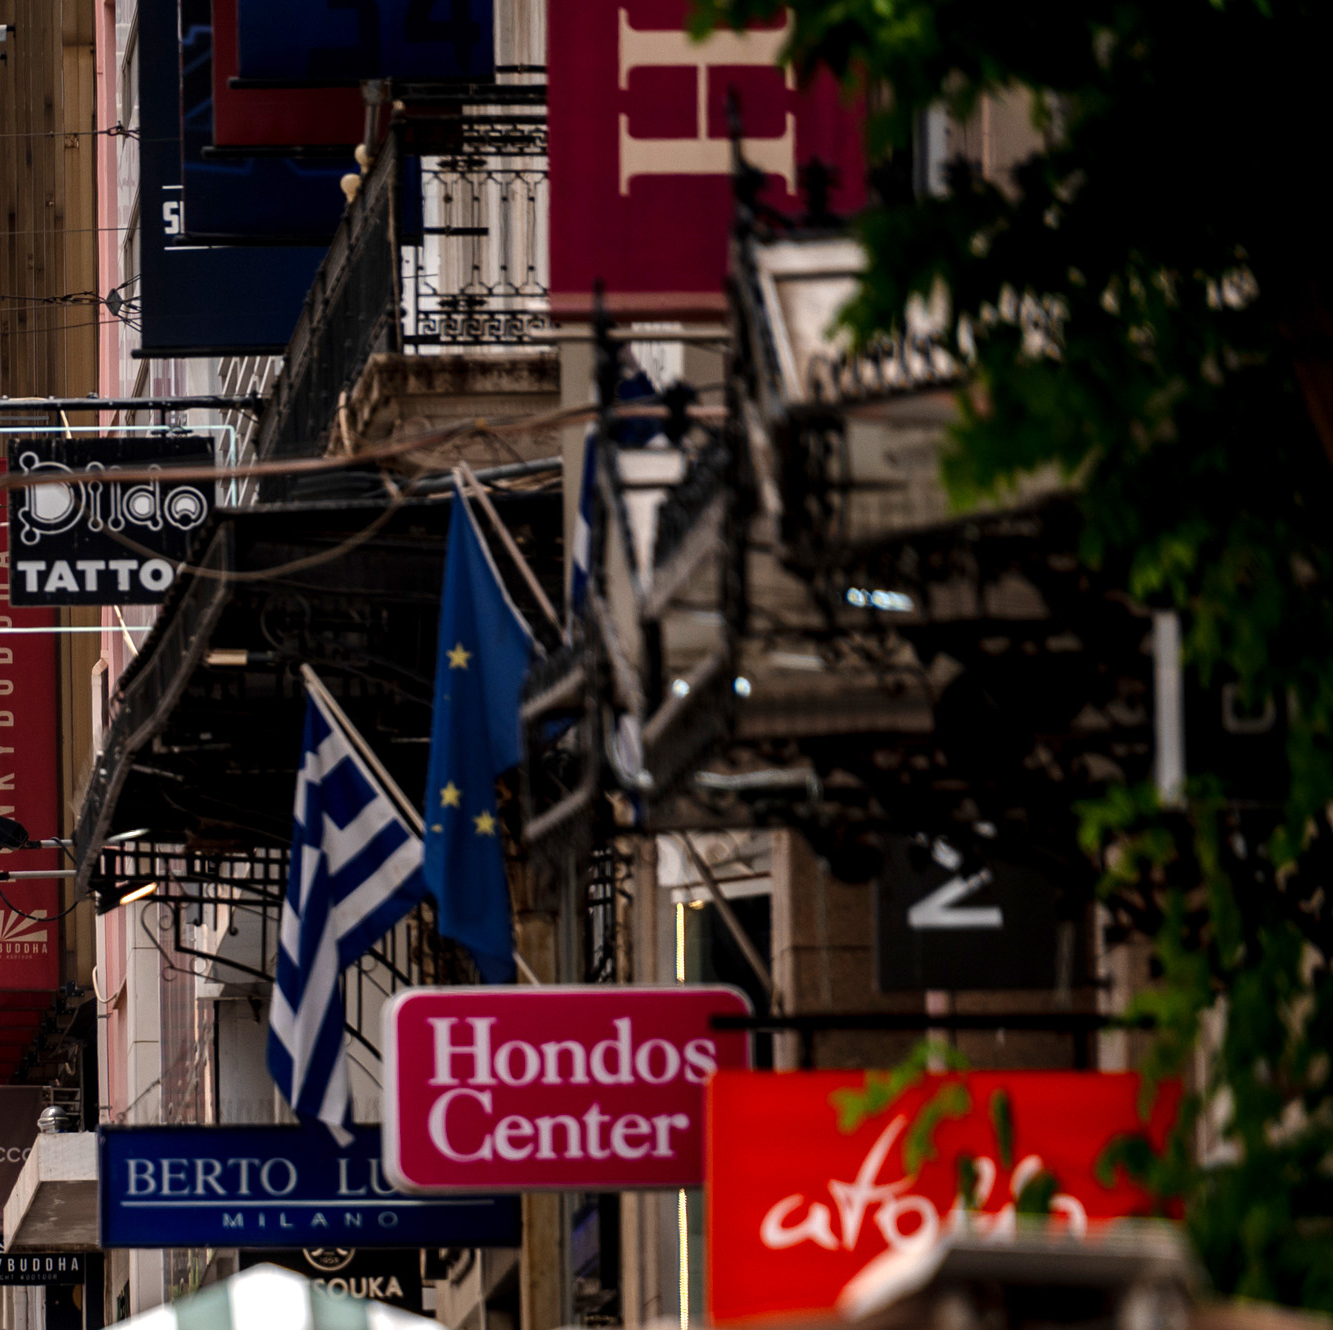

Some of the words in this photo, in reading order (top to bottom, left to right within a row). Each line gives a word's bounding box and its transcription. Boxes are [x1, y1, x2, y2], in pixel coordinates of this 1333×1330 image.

[428, 1016, 718, 1087] Hondos
[428, 1088, 690, 1163] Center
[126, 1157, 298, 1197] BERTO
[222, 1211, 399, 1228] MILANO
